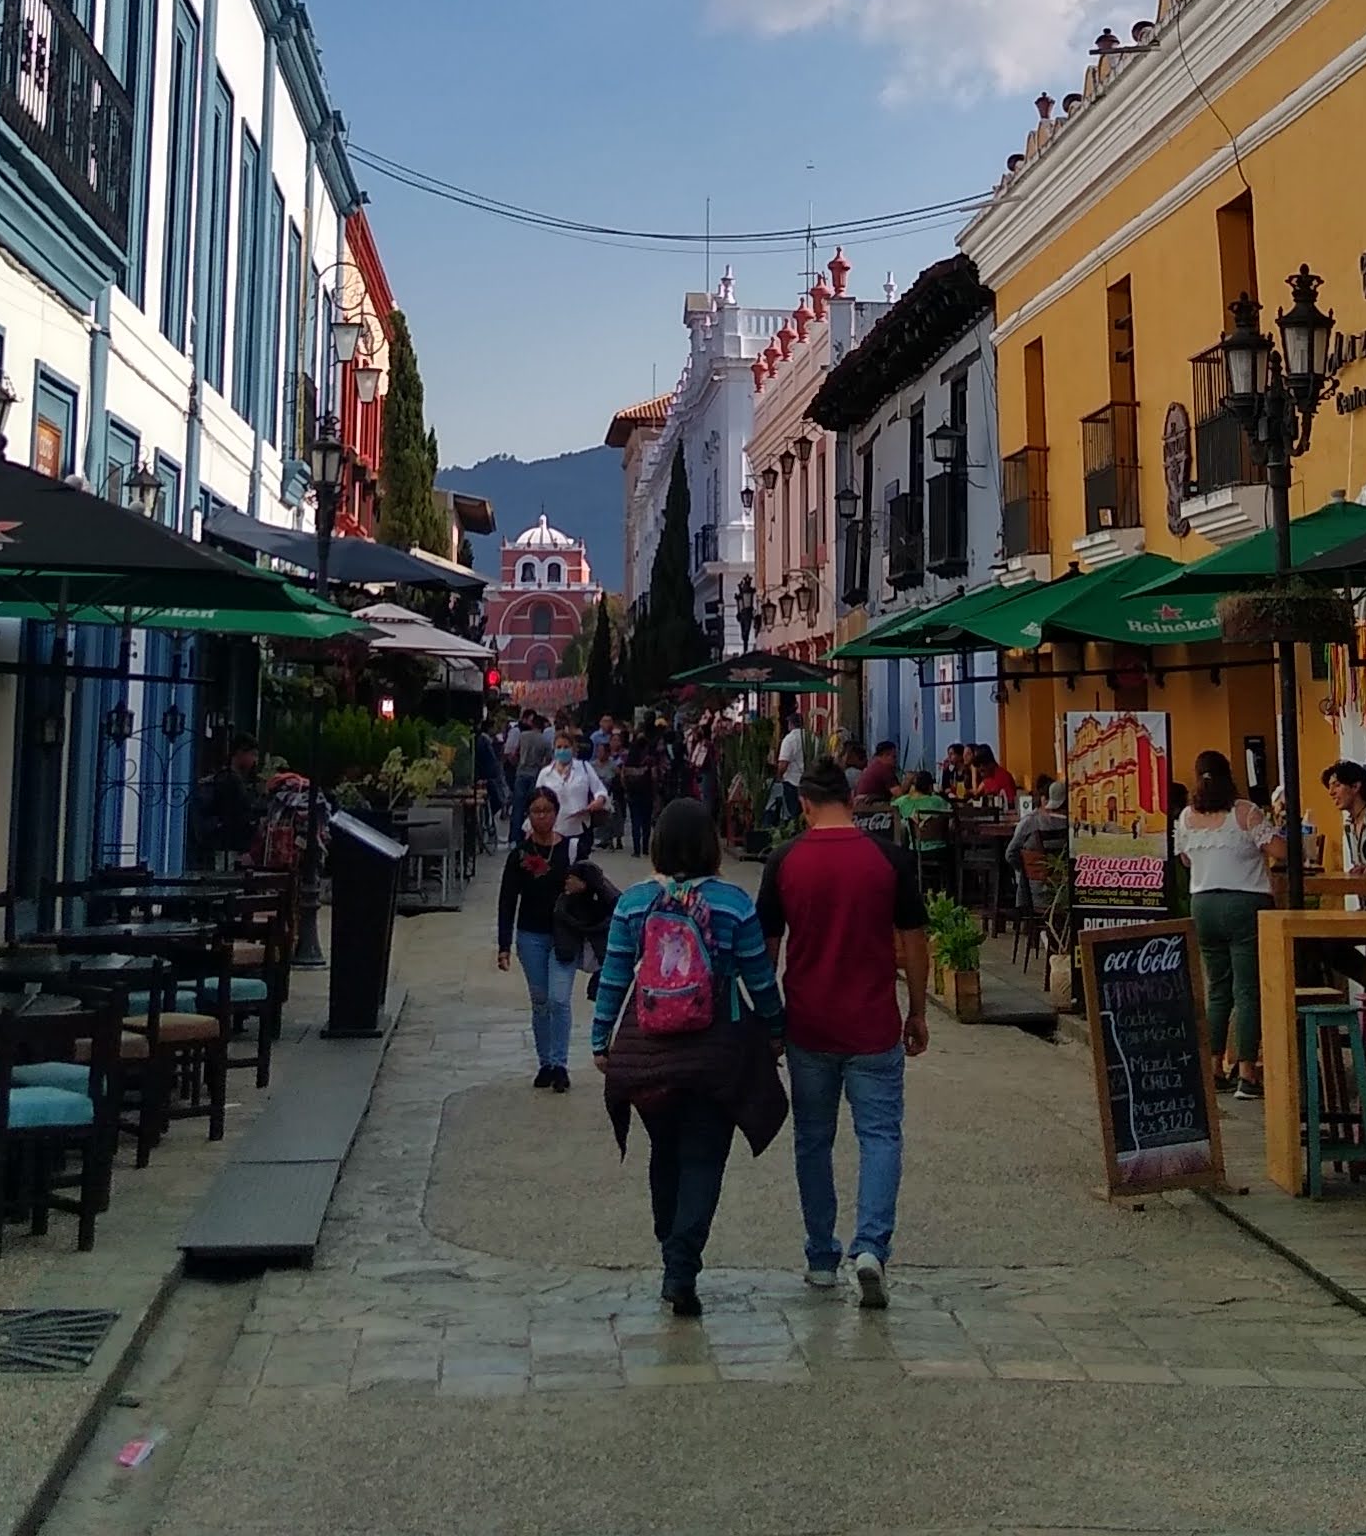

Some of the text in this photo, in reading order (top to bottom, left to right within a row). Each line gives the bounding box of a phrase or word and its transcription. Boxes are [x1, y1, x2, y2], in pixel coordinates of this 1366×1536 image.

[1074, 853, 1165, 873] Encuentro
[1074, 870, 1165, 889] Artesanal
[1119, 888, 1129, 896] de
